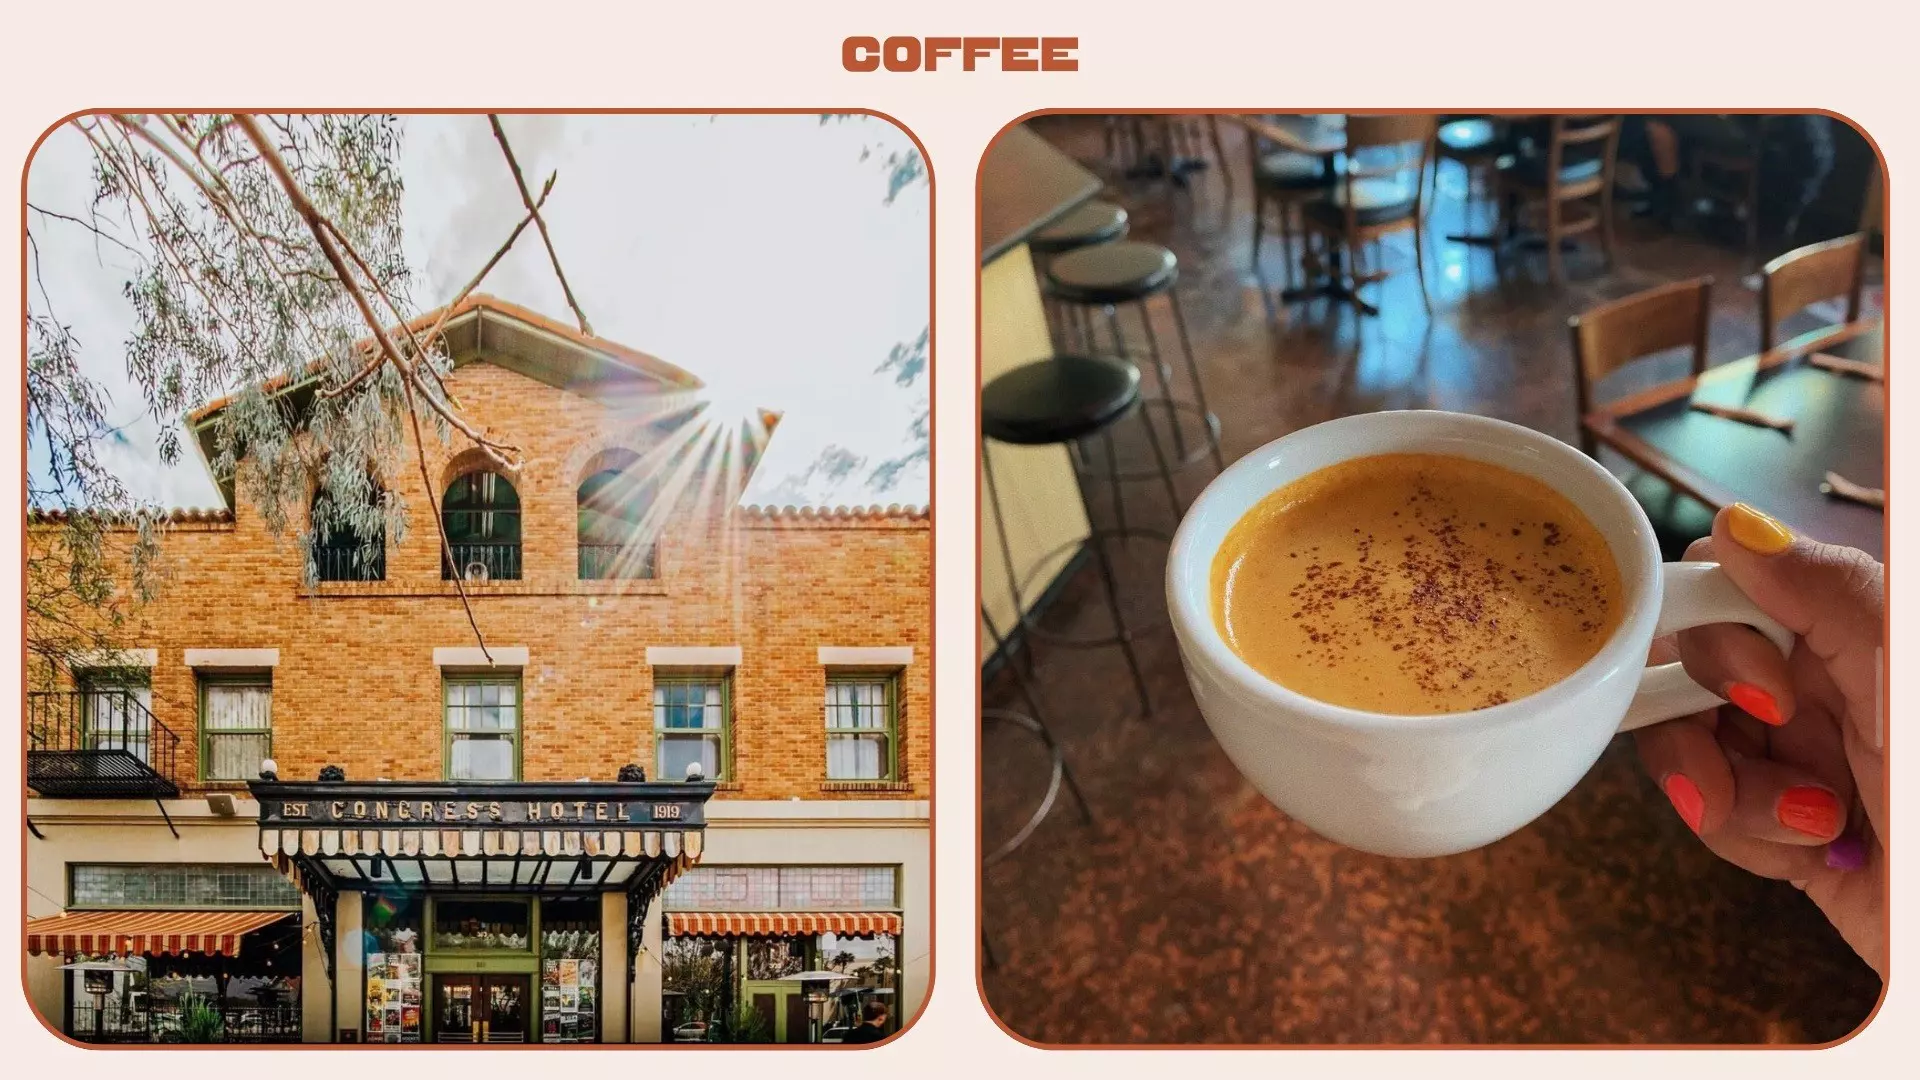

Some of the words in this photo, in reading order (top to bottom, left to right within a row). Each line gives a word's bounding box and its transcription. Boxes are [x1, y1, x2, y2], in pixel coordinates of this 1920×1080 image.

[283, 803, 309, 816] EST
[332, 801, 501, 820] CONGRESS
[528, 802, 630, 820] HOTEL
[654, 805, 680, 818] 1919
